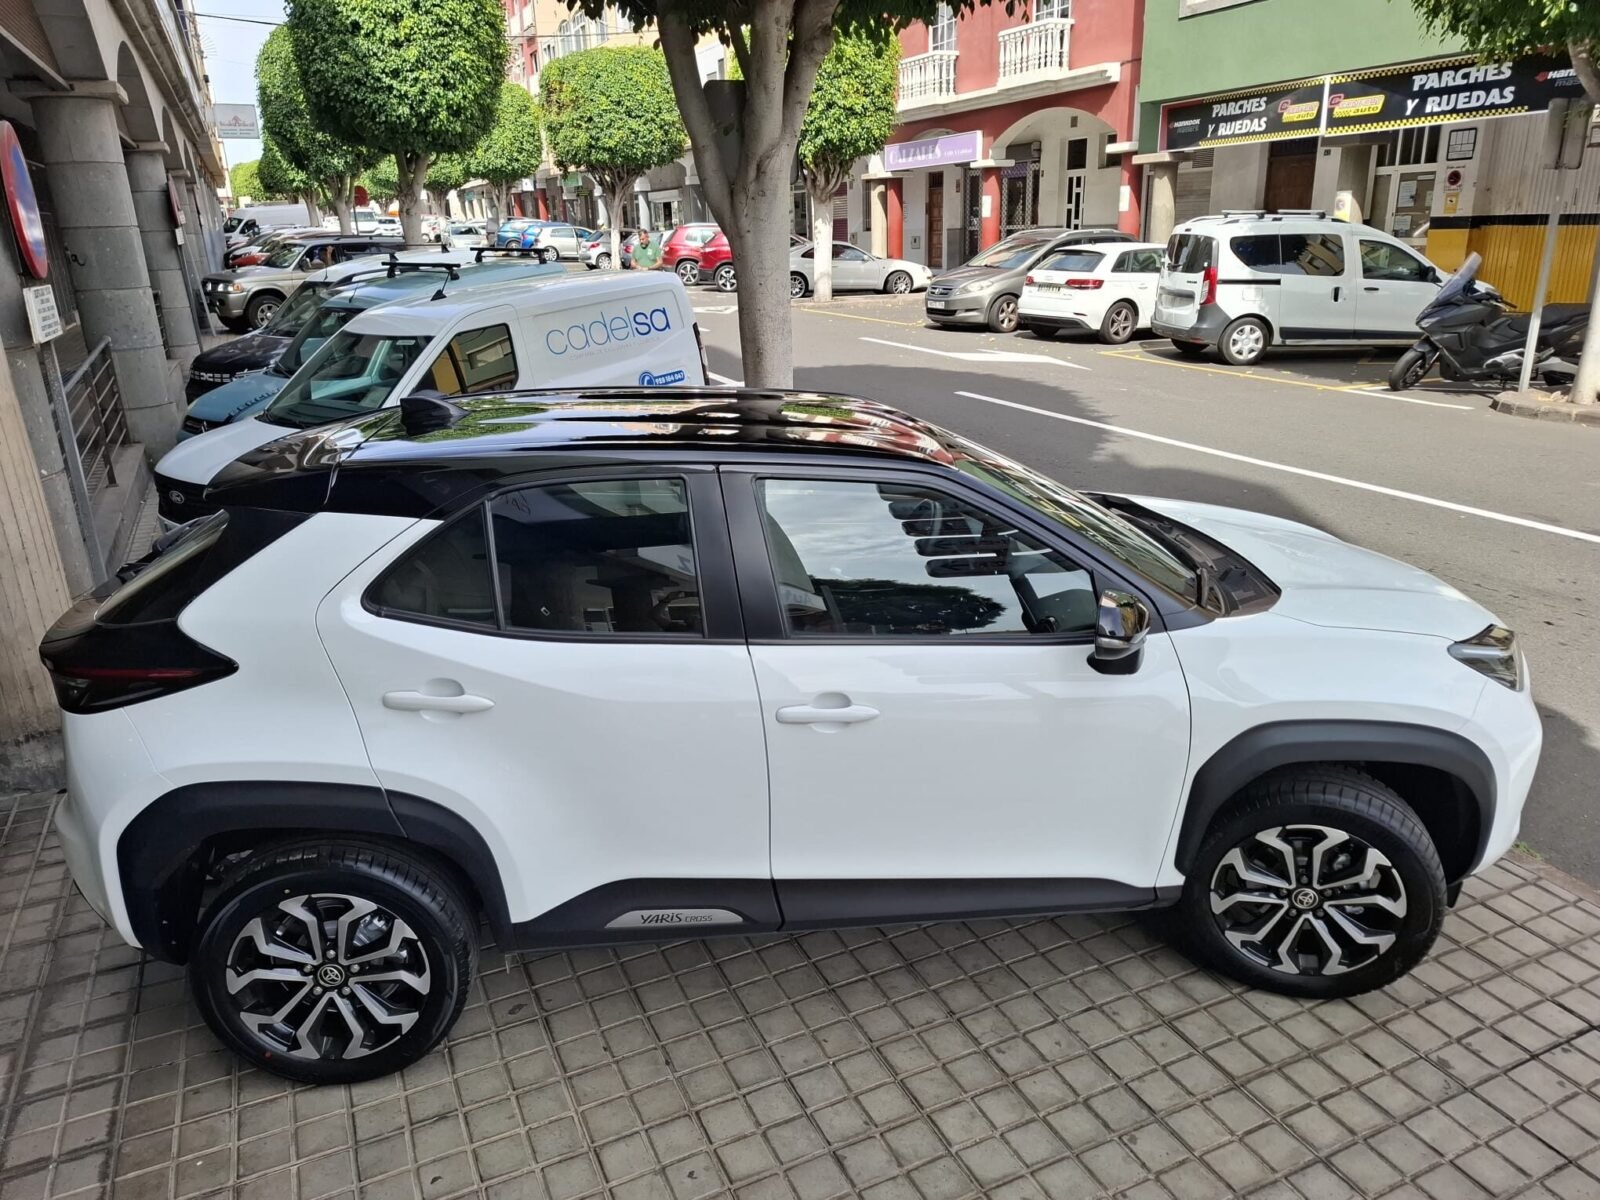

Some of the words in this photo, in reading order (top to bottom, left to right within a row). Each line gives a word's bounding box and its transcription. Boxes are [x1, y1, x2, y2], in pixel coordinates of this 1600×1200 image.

[1412, 61, 1513, 92] PARCHES
[1212, 97, 1267, 118] PARCHES
[1405, 98, 1419, 116] Y
[1425, 86, 1515, 114] RUEDAS
[1207, 123, 1216, 138] Y
[1217, 117, 1268, 136] RUEDAS
[546, 306, 671, 355] cadelsa
[685, 915, 713, 923] CROSS
